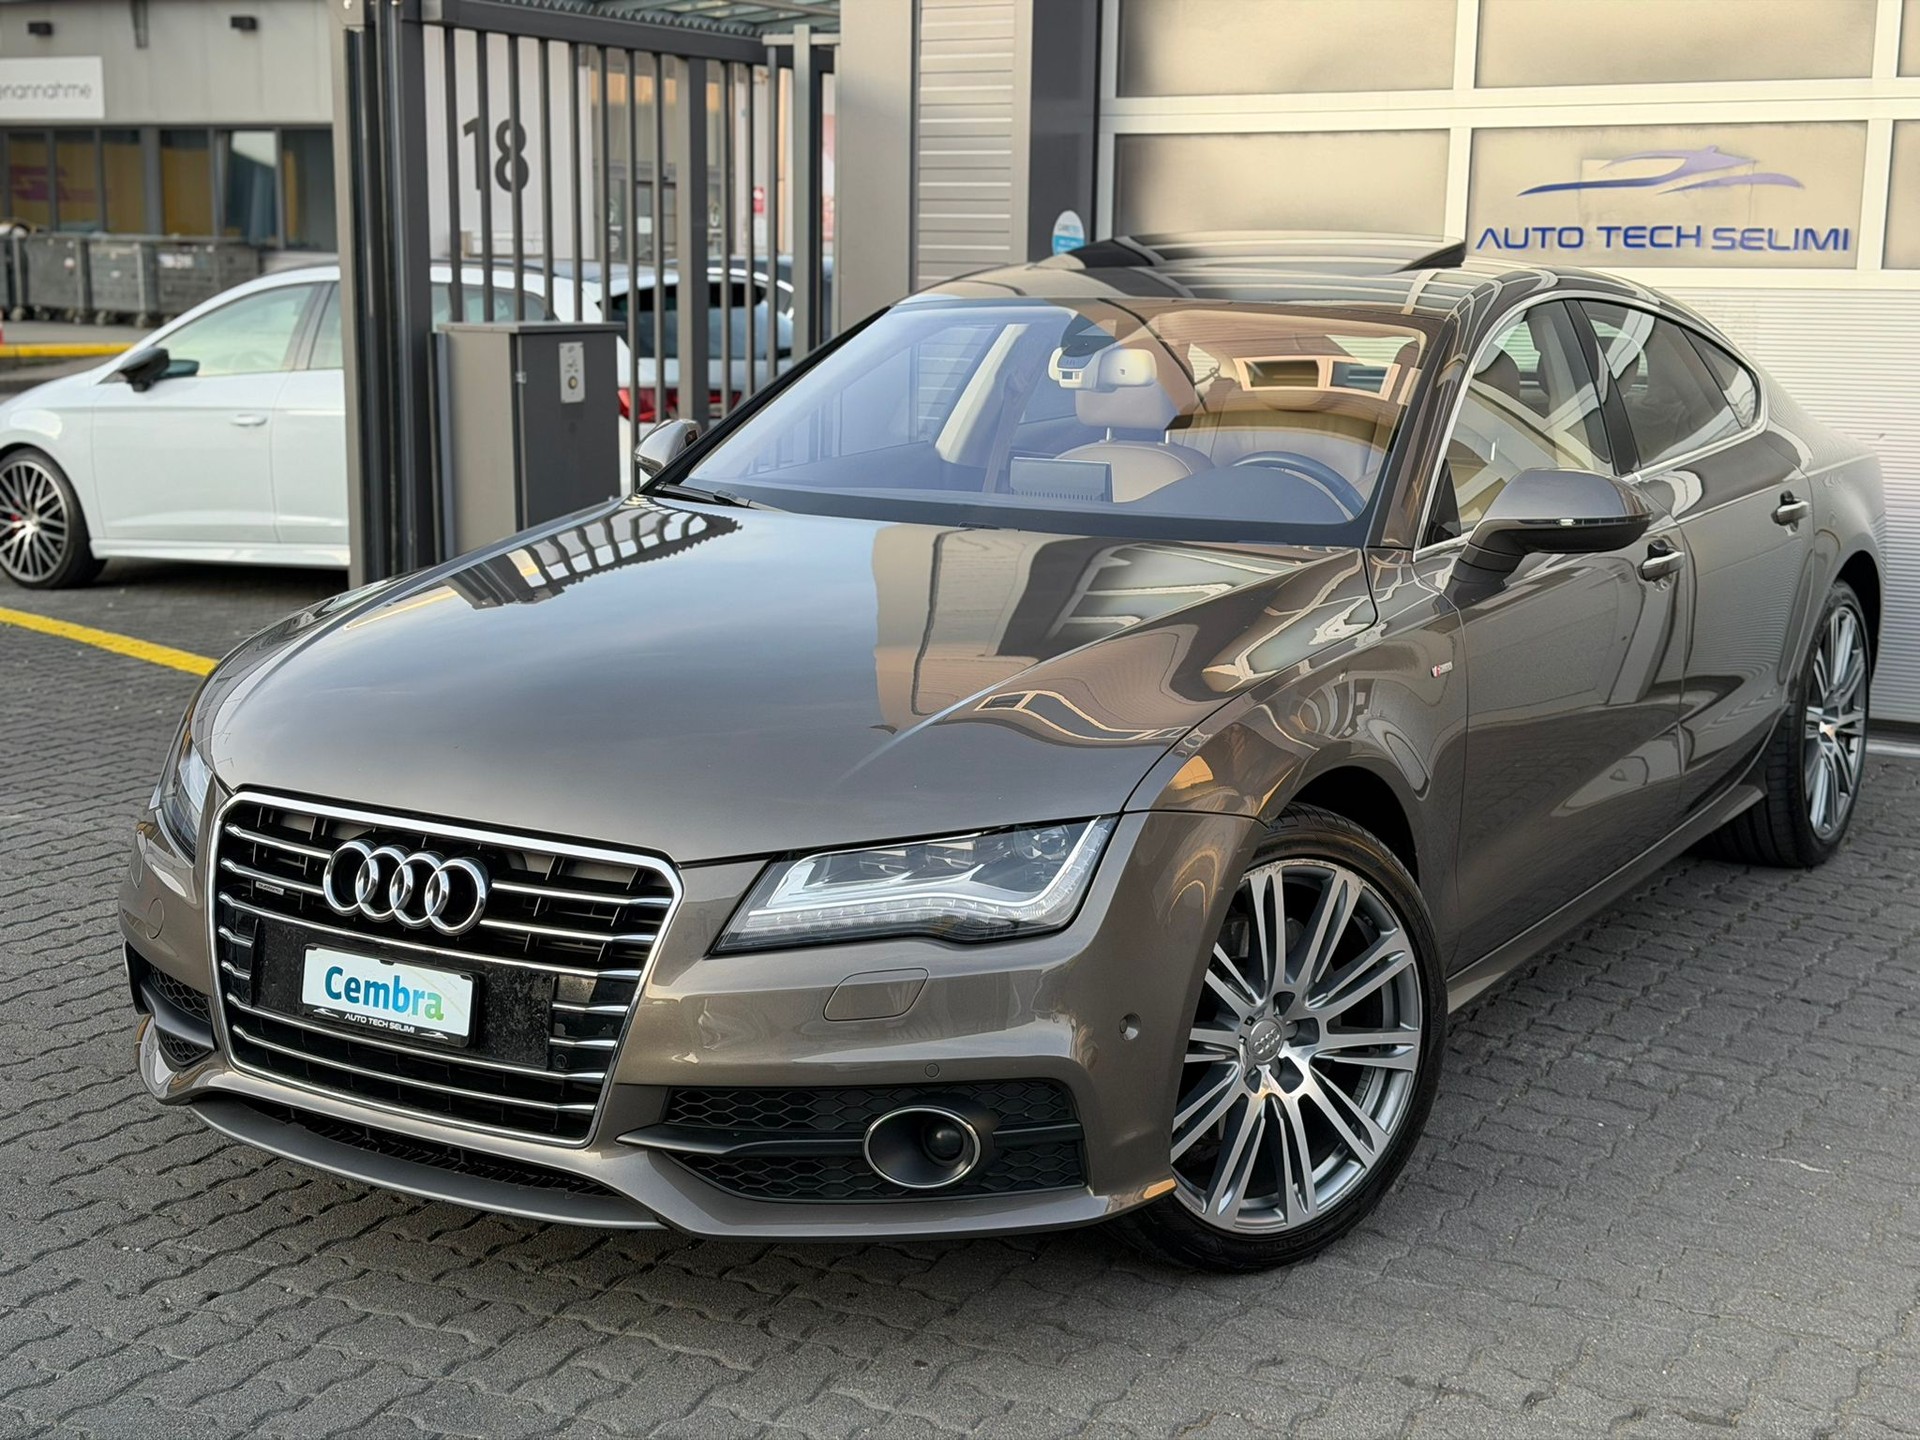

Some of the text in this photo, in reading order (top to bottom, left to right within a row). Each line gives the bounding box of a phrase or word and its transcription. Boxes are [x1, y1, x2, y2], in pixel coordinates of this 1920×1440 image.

[463, 117, 529, 193] 18
[1475, 225, 1850, 251] AUTO TECH SELIMI
[324, 965, 445, 1022] Cembra
[344, 1013, 416, 1034] AUTO TECH SELIMI
